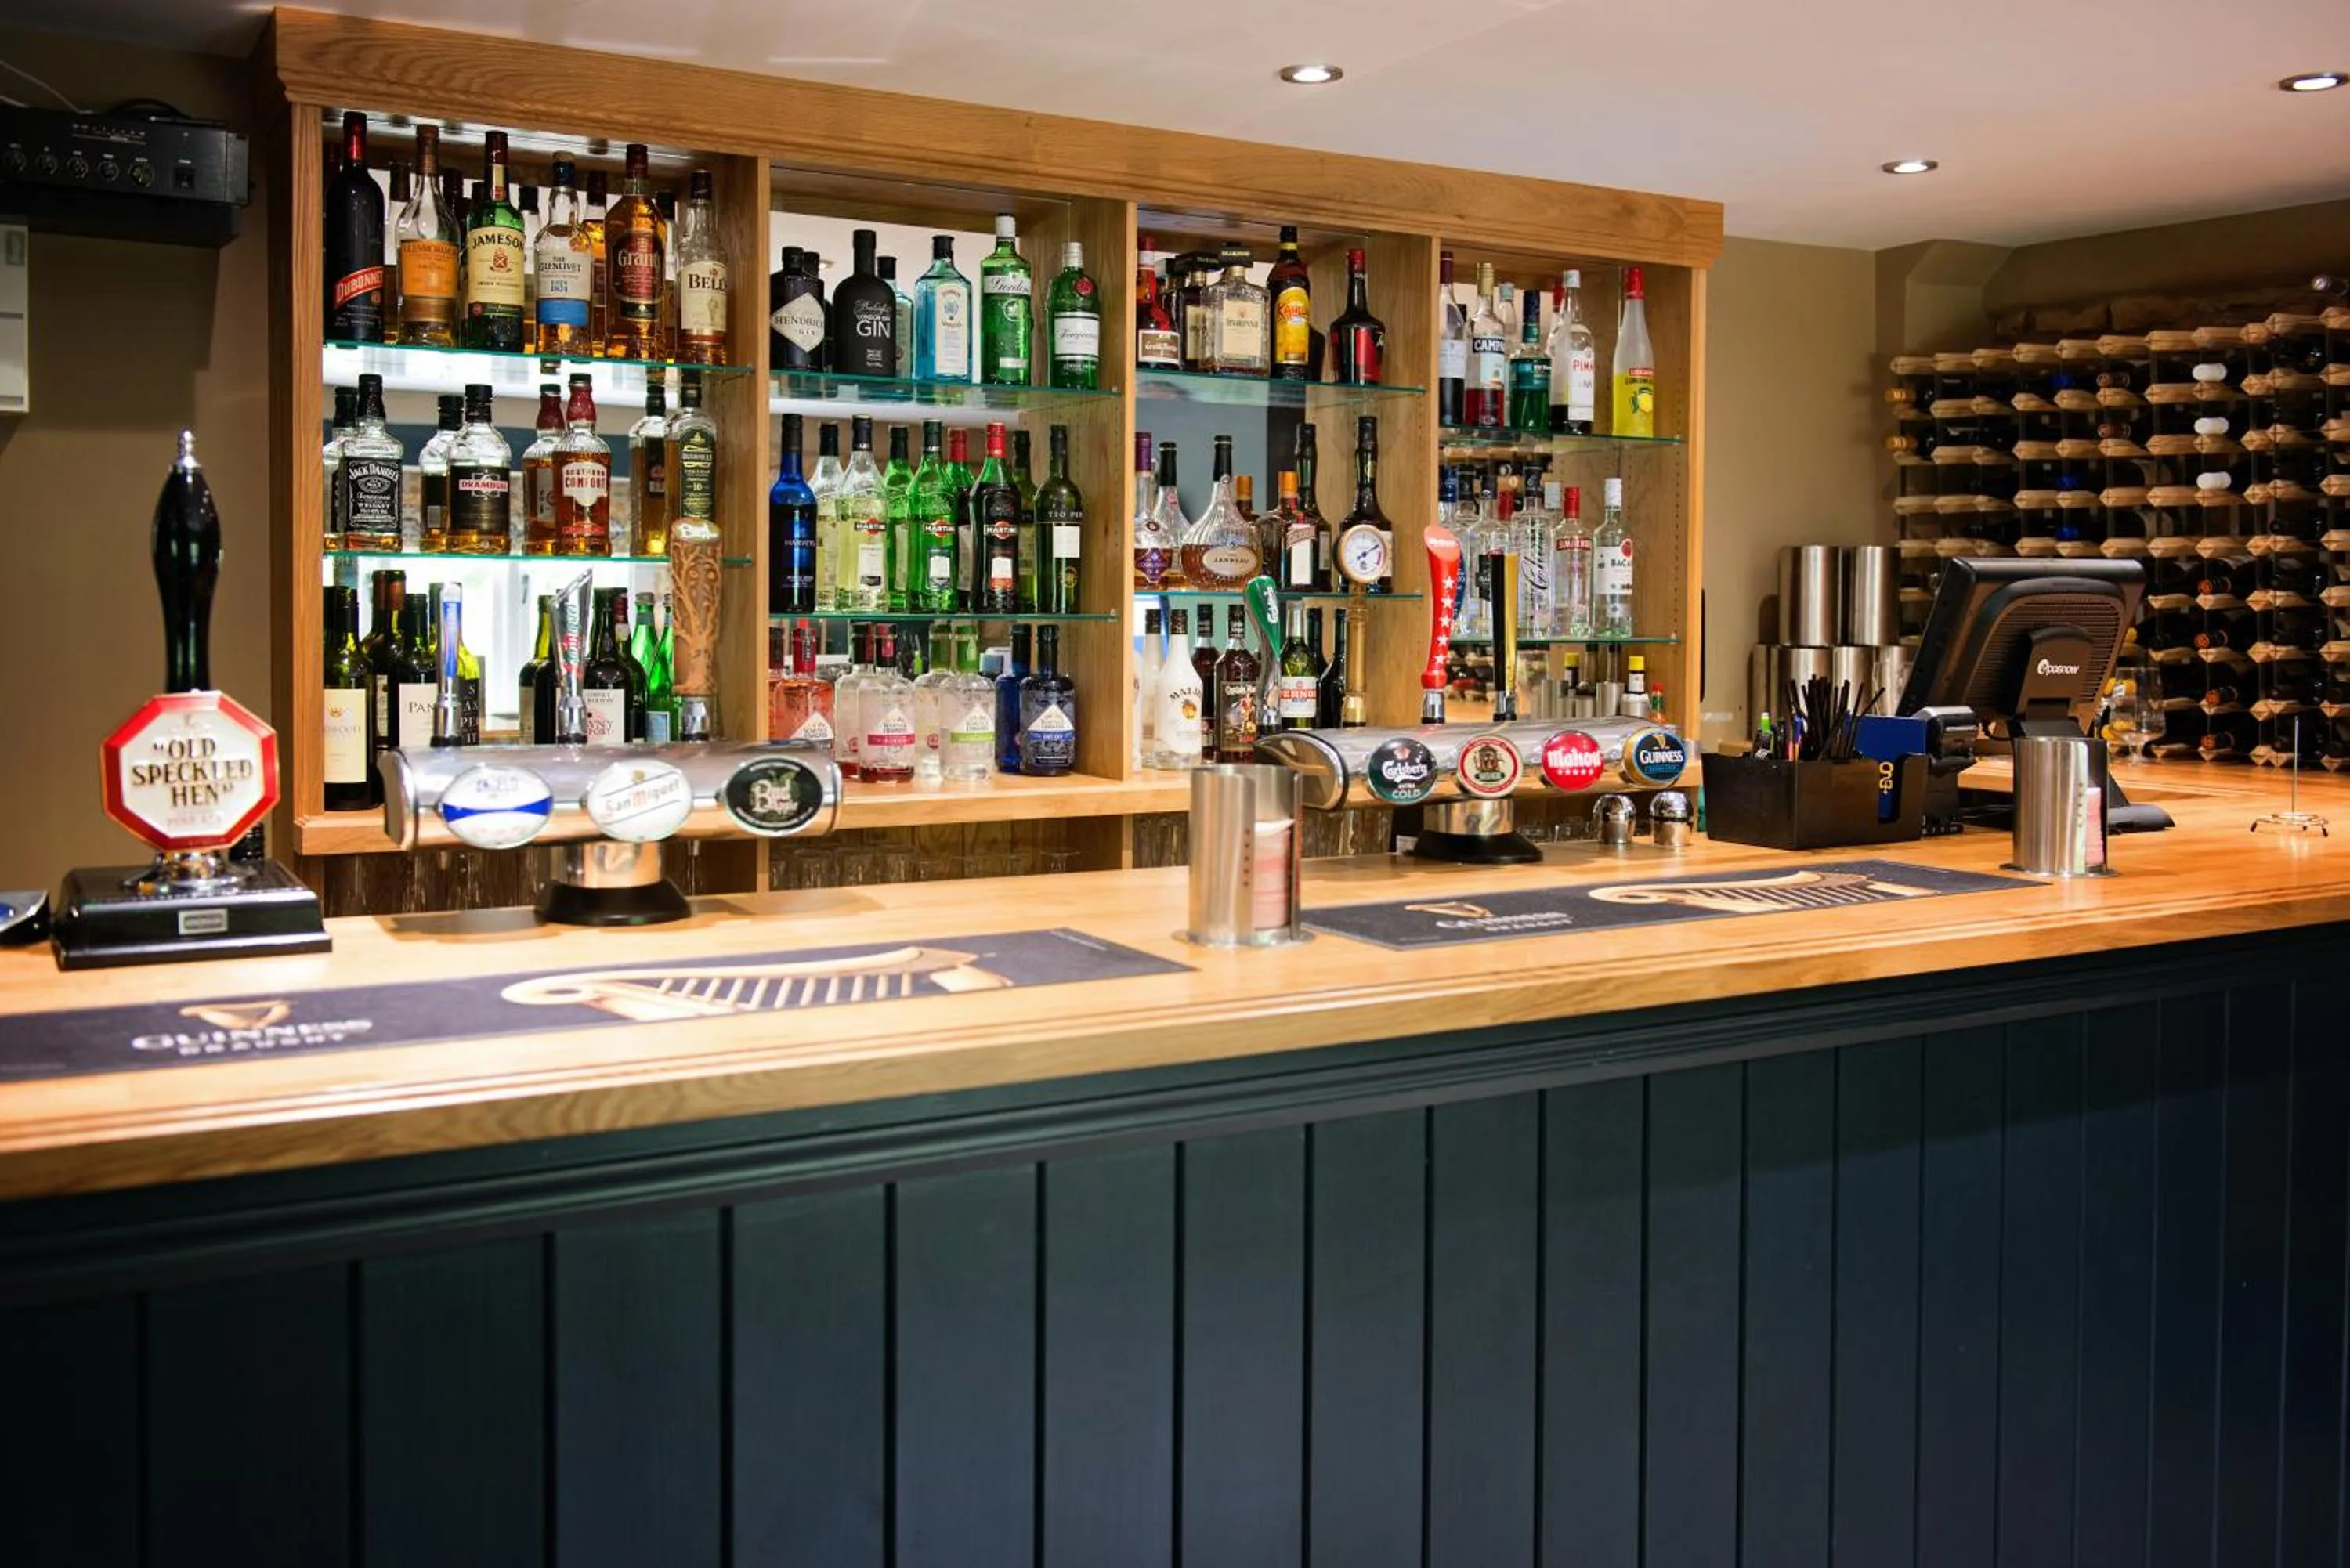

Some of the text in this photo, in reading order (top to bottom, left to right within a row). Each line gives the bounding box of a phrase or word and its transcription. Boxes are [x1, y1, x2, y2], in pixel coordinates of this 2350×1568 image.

[539, 262, 582, 273] GLENLIVET
[856, 320, 891, 338] GIN
[565, 477, 606, 488] COMFORT
[1548, 747, 1602, 768] Mahou
[1640, 750, 1683, 764] GUINNESS
[131, 758, 254, 788] SPECKLED
[1381, 760, 1428, 782] Carlsberg
[601, 779, 680, 819] San Miguel
[1391, 789, 1421, 799] COLD
